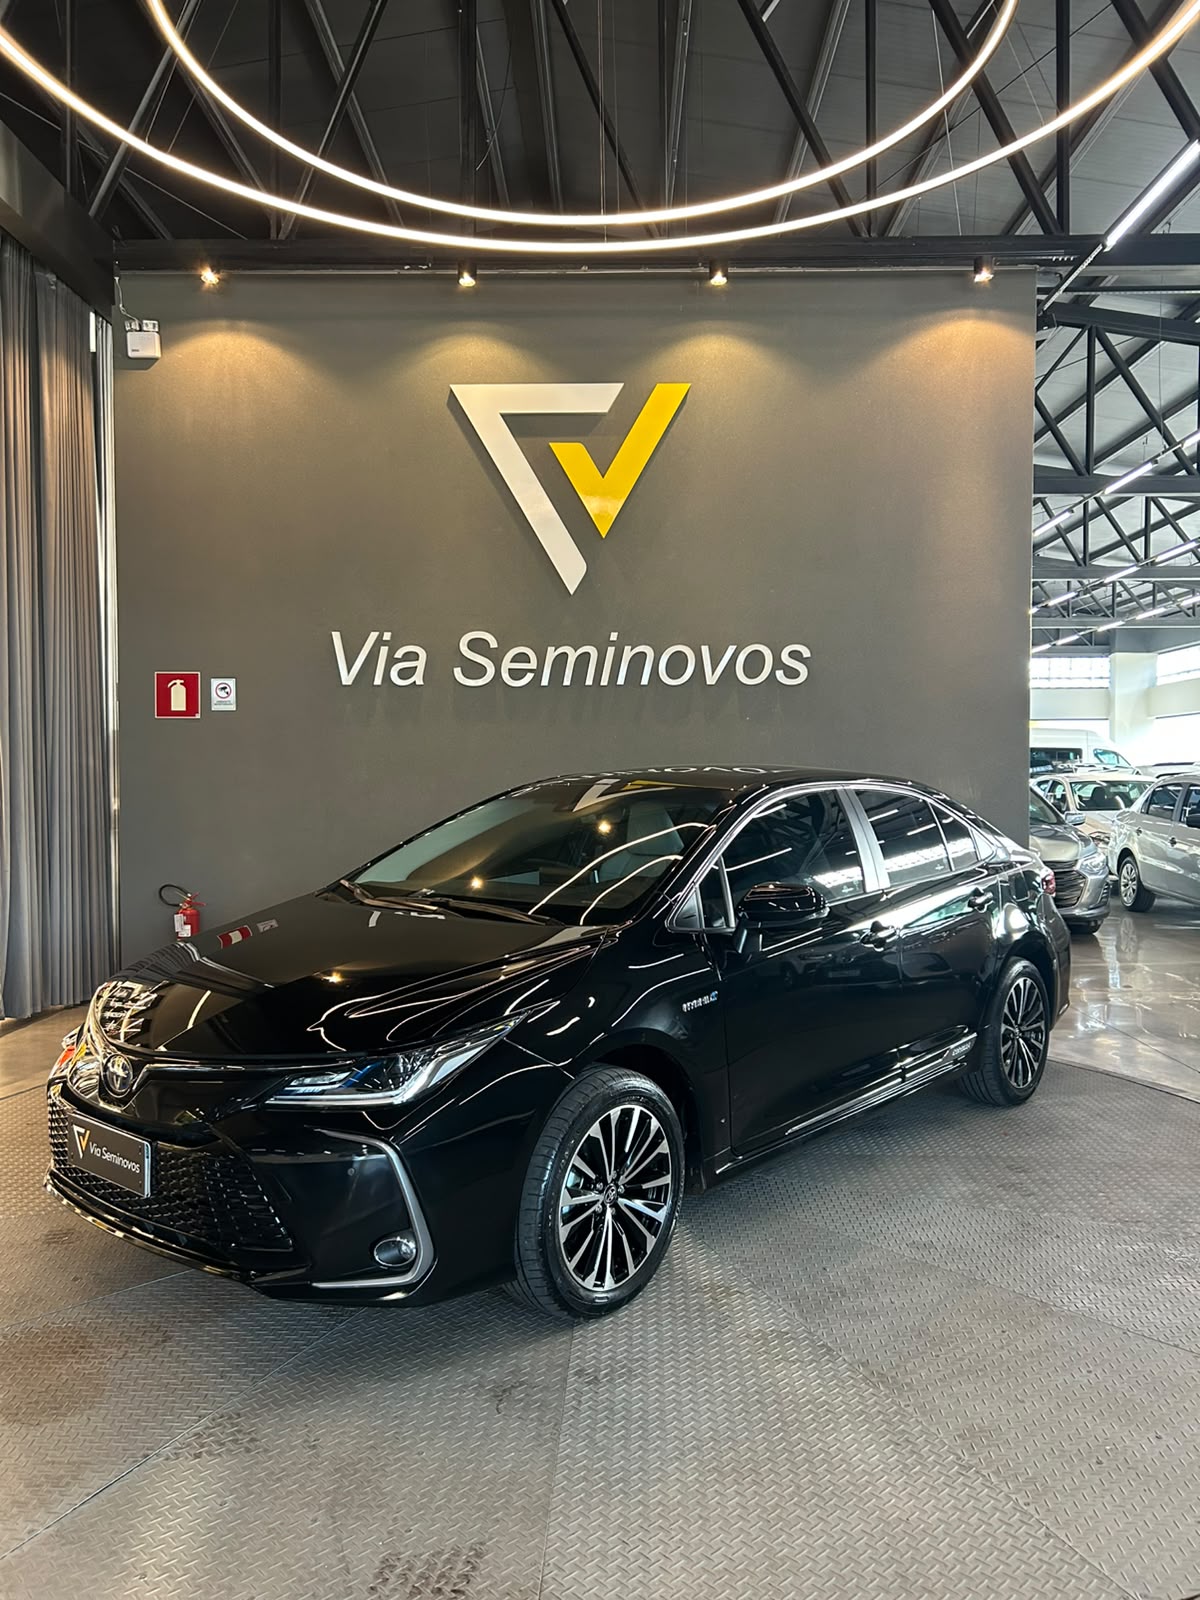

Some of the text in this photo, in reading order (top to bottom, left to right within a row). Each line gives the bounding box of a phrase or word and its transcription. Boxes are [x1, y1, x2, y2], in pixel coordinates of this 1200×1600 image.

[332, 631, 811, 686] Via Seminovos
[89, 1142, 140, 1173] Via Seminovos
